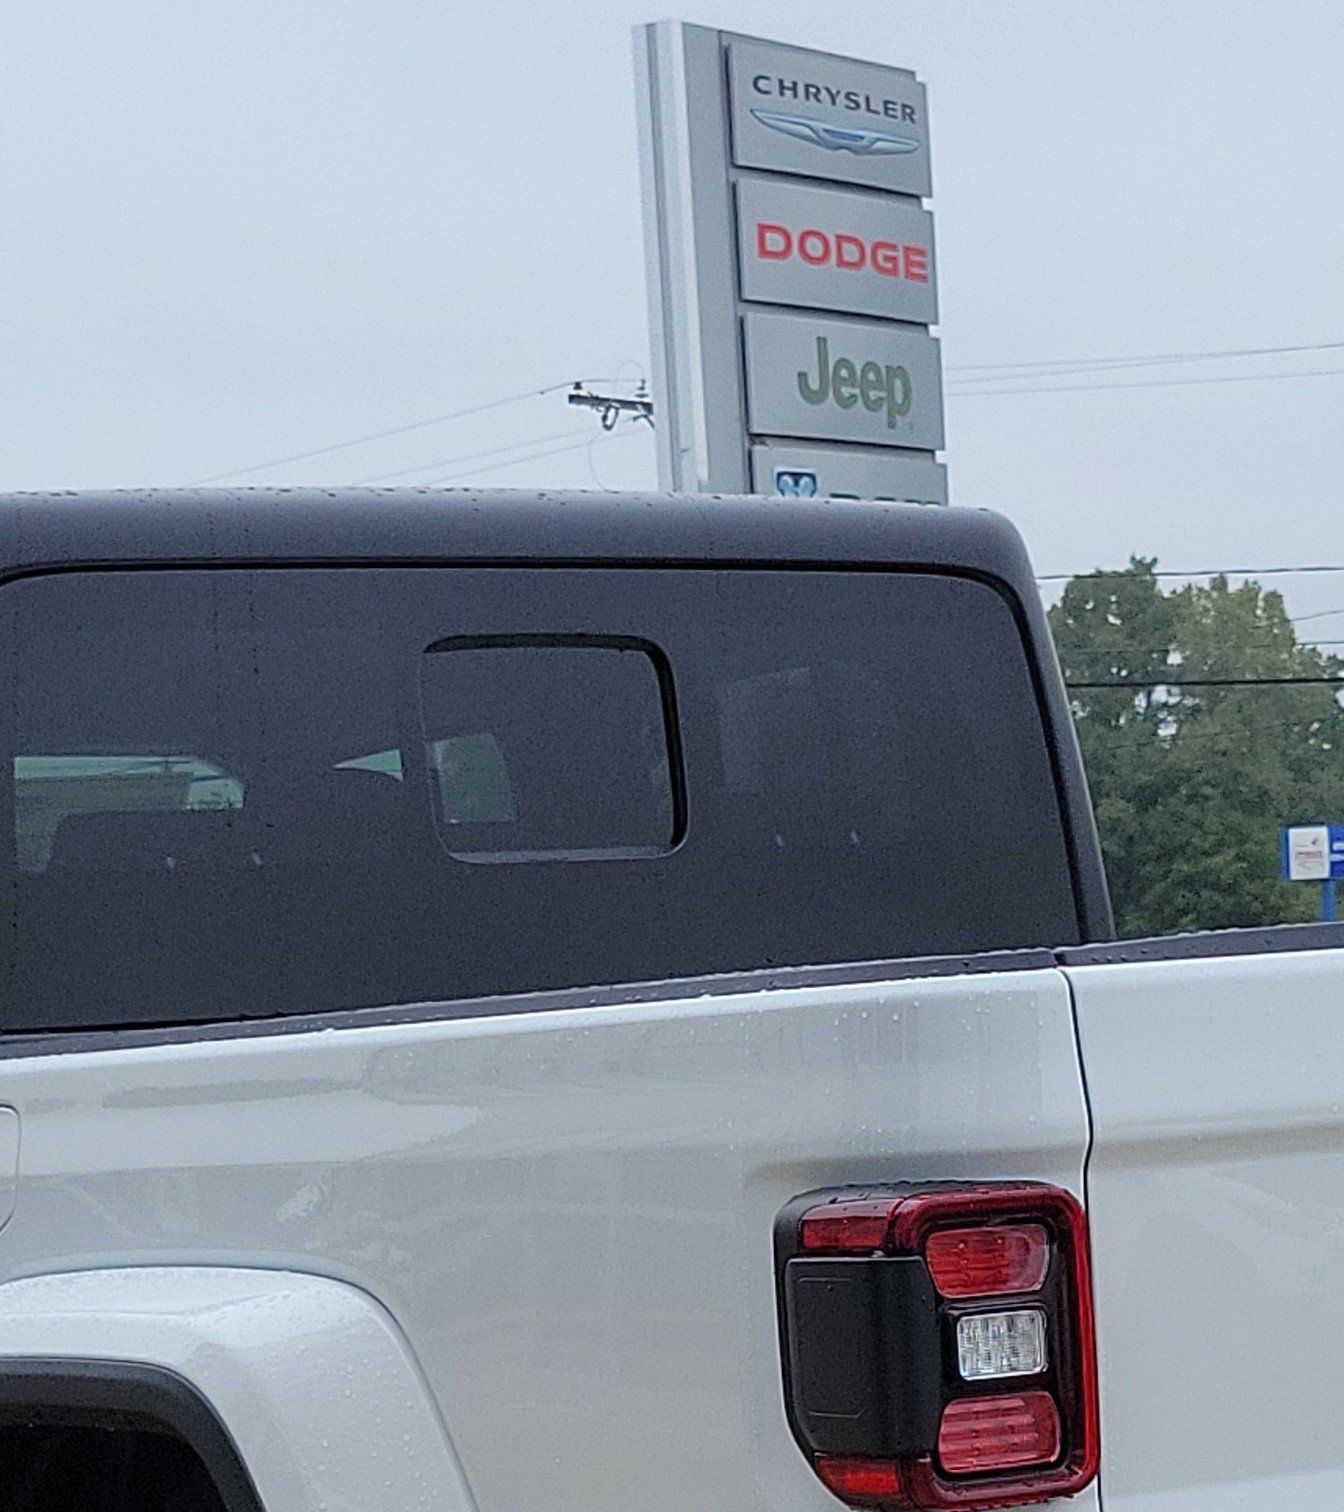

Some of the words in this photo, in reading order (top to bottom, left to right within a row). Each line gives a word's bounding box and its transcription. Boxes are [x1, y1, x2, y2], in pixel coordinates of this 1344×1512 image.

[752, 74, 917, 125] CHRYSLER
[757, 222, 929, 283] DODGE
[798, 337, 913, 429] Jeep
